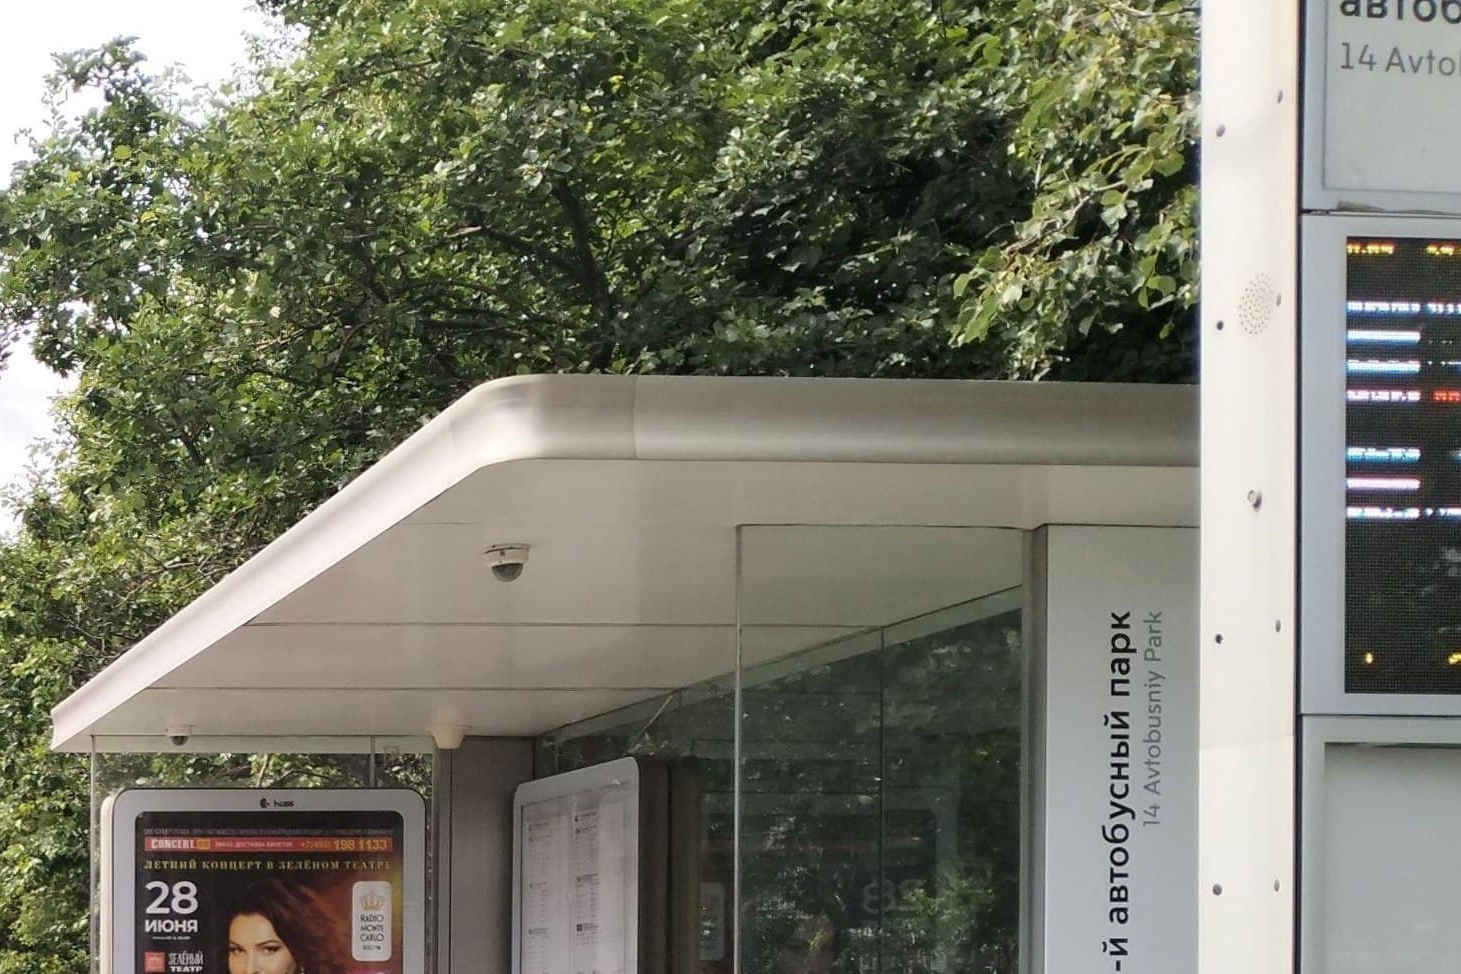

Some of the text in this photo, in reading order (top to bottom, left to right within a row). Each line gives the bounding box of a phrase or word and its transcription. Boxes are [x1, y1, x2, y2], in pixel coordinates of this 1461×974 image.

[1341, 42, 1461, 76] 14 Avto
[1110, 611, 1138, 696] парк
[1142, 611, 1166, 827] 14 Avtobusniy Park
[1101, 710, 1136, 924] автобусный
[143, 859, 197, 870] ЛЕТНИЙ
[202, 860, 262, 872] КОНЦЕРТ
[145, 880, 199, 914] 28
[360, 914, 384, 923] RADIO
[144, 919, 198, 933] ИЮНЯ
[360, 924, 384, 932] MONTE
[360, 933, 384, 942] CARLO
[169, 965, 203, 973] ТЕАТР
